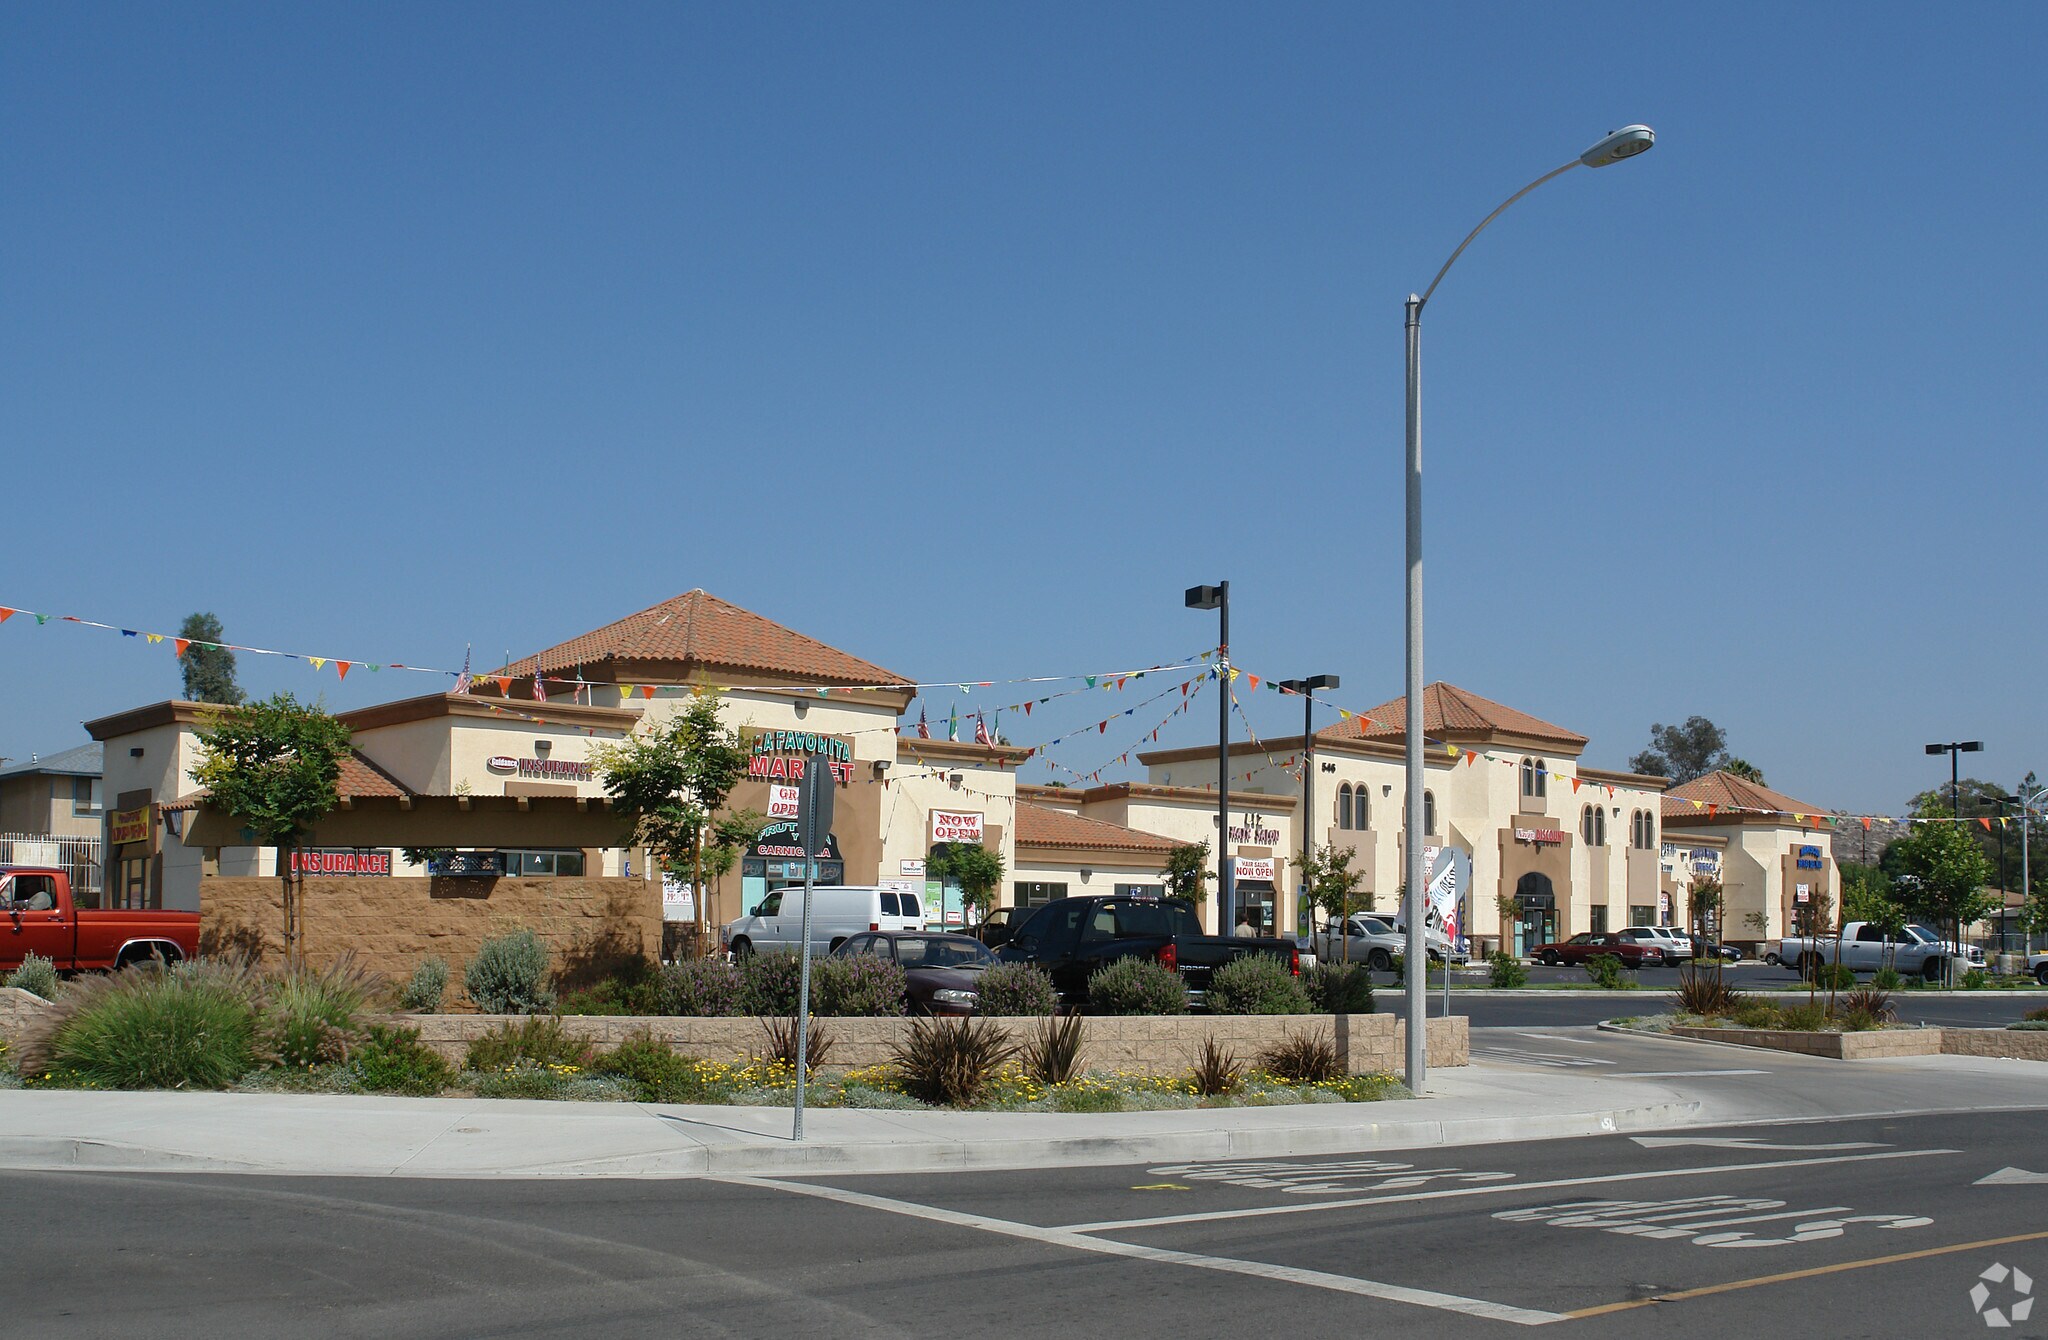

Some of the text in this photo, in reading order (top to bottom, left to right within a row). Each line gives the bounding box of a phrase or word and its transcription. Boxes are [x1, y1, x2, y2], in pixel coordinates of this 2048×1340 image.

[776, 731, 852, 762] FAVORITA
[748, 755, 855, 783] MARET
[779, 788, 798, 801] GR
[938, 814, 978, 827] NOW
[791, 832, 799, 841] Y
[935, 827, 980, 840] OPEN
[1536, 829, 1565, 842] DISCOUNT
[758, 845, 831, 858] CARNICA
[291, 852, 389, 874] INSURANCE
[534, 856, 542, 864] A
[790, 862, 796, 870] B
[1236, 867, 1273, 877] NOW OPEN
